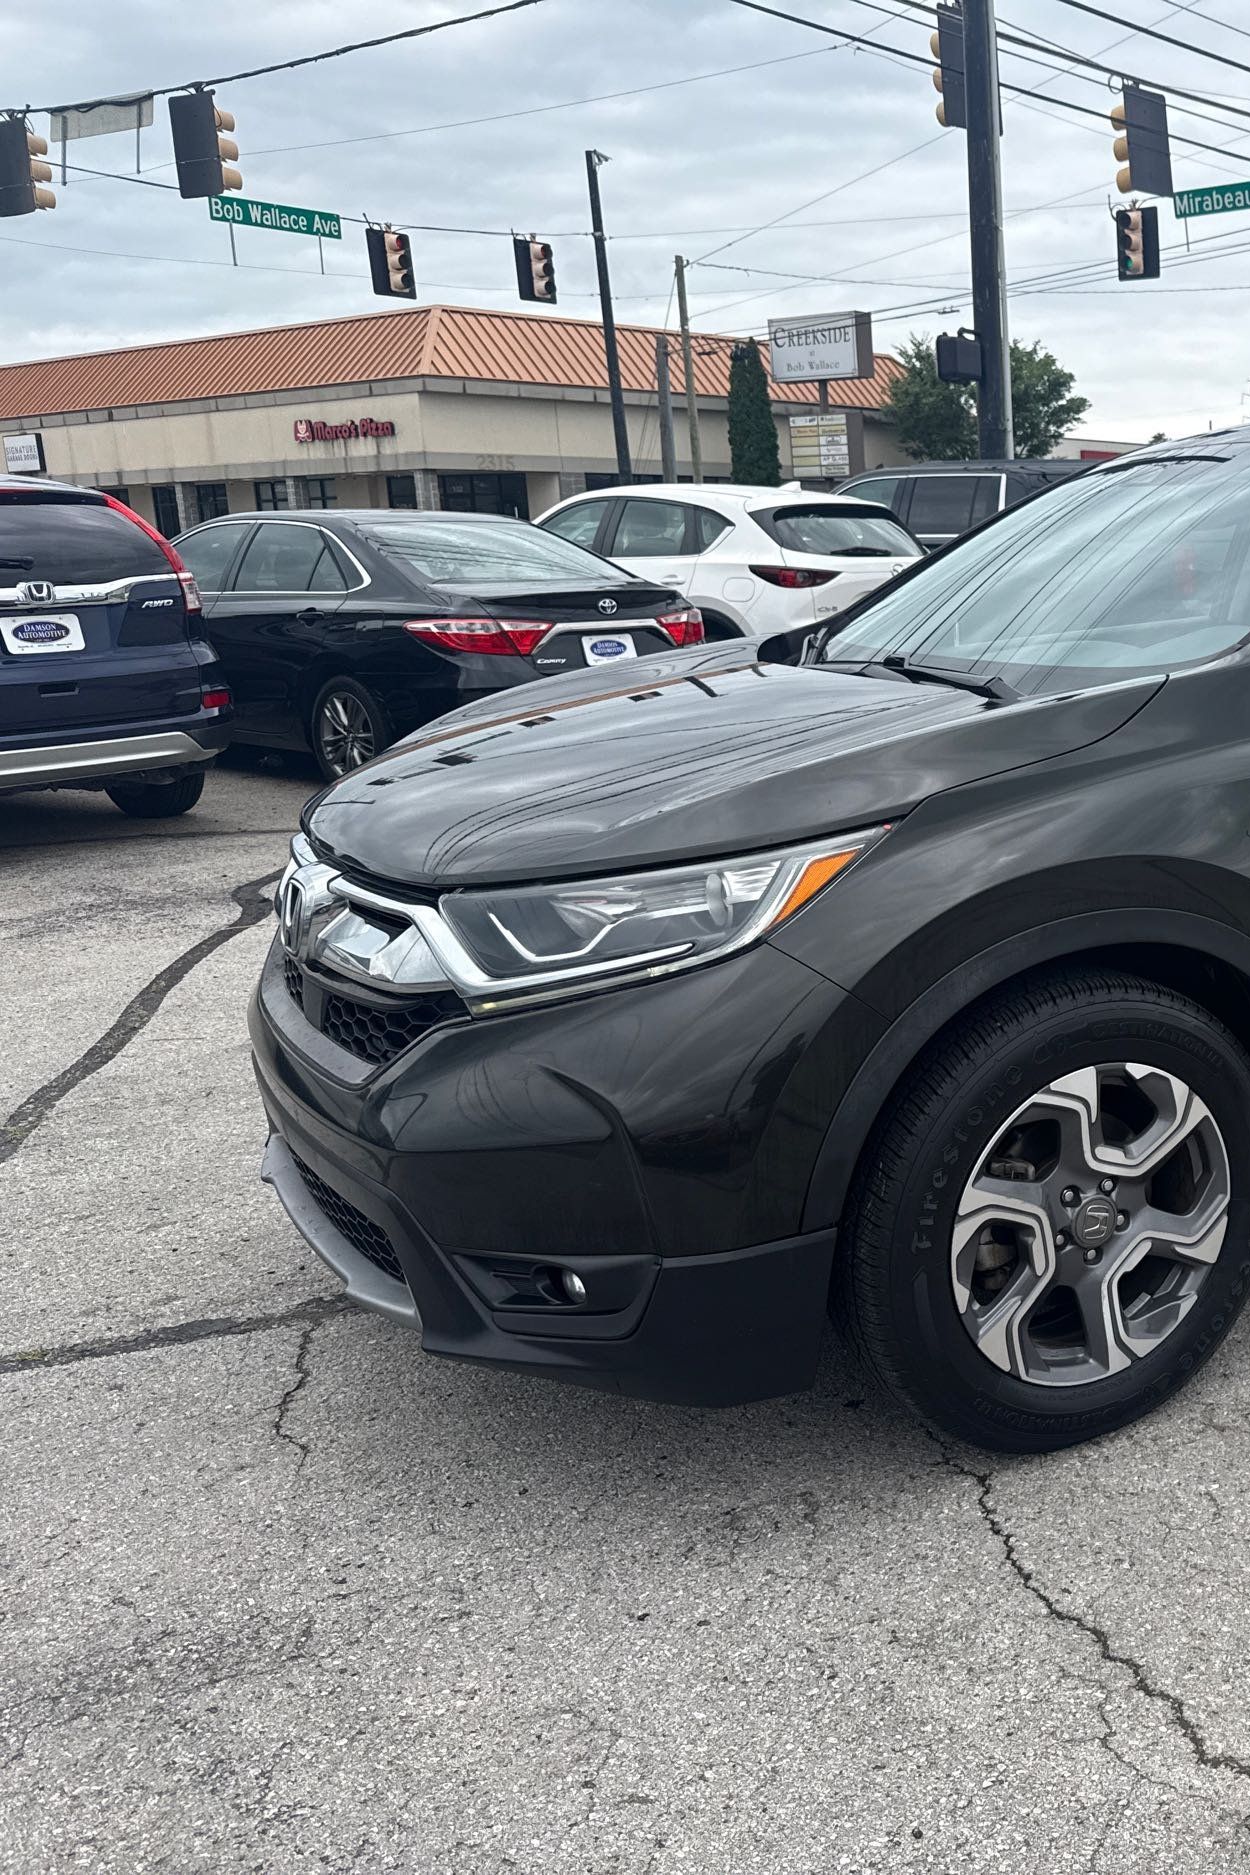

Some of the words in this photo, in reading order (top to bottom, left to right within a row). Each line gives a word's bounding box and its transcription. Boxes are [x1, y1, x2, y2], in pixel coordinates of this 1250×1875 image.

[211, 198, 243, 221] Bob
[248, 203, 307, 230] Wallace
[313, 214, 340, 236] Ave
[774, 326, 851, 348] CREEKSIDE
[787, 362, 805, 372] Bob
[808, 360, 840, 370] Wallace
[314, 420, 358, 441] Marco's
[360, 418, 394, 437] Pizza
[5, 444, 37, 455] SIGNATURE
[477, 455, 515, 471] 2315
[142, 599, 175, 609] AWD
[24, 623, 57, 632] DAMSON
[18, 629, 67, 640] AUTOMOTIVE
